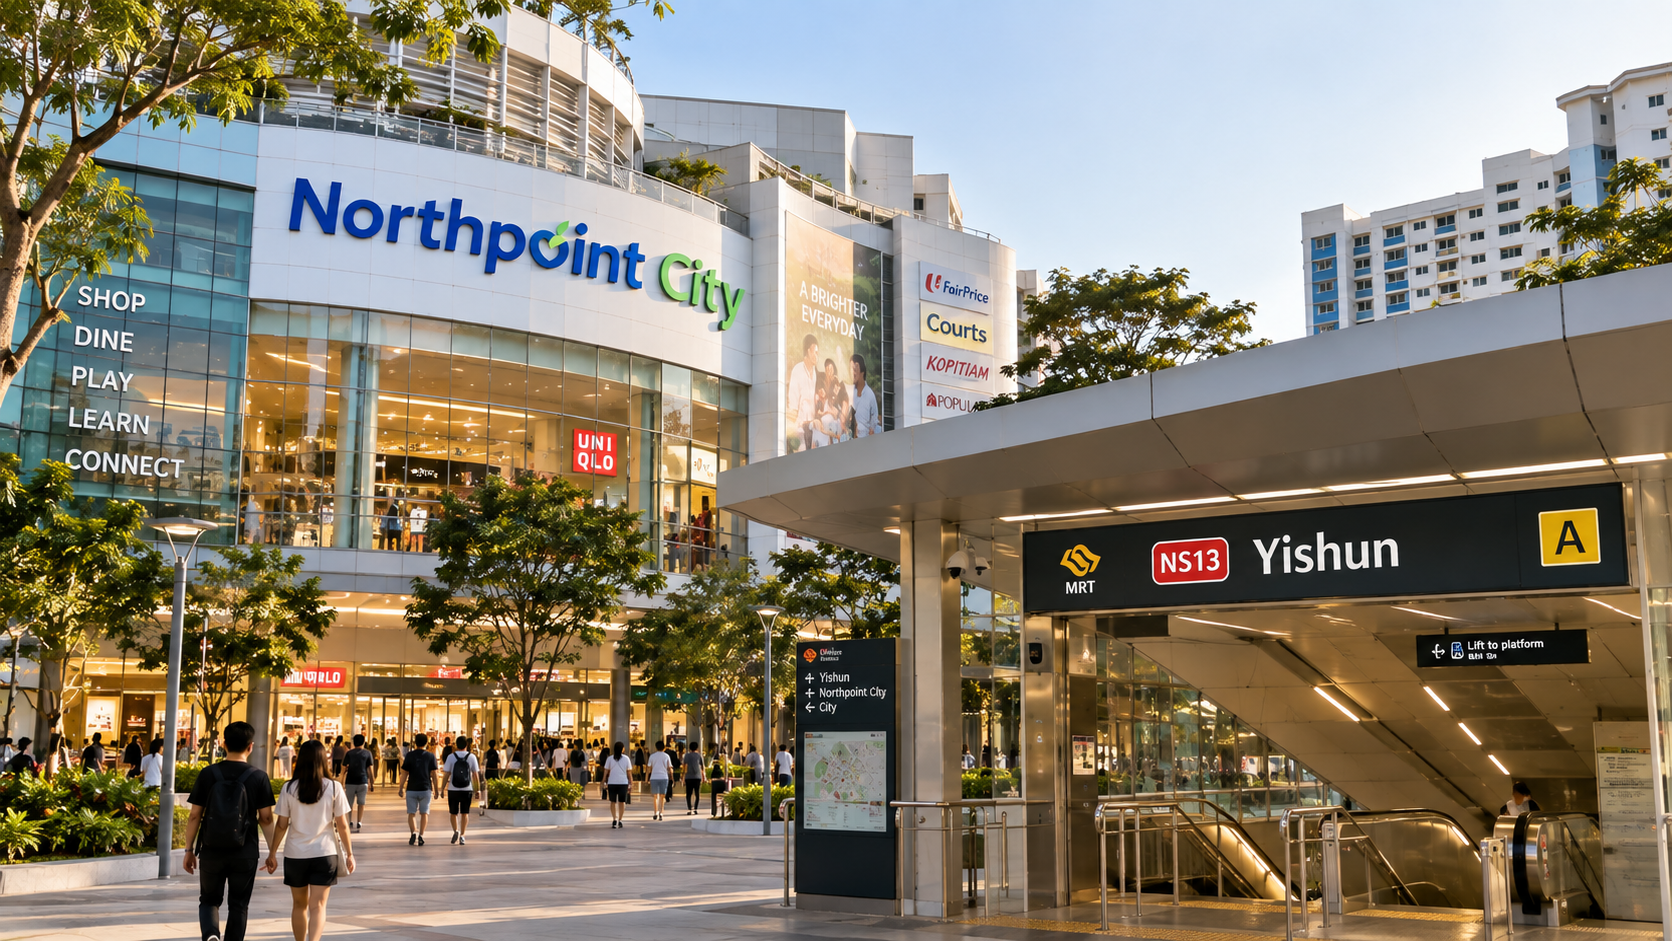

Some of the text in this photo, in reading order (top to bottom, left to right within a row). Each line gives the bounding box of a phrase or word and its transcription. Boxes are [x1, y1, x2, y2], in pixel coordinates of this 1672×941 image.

[288, 177, 746, 332] Northpoint City
[77, 285, 146, 313] SHOP
[799, 280, 869, 321] A BRIGHTER
[943, 280, 989, 304] FairPrice
[802, 303, 865, 341] EVERYDAY
[926, 312, 988, 344] Courts
[74, 325, 135, 353] DINE
[72, 365, 134, 393] PLAY
[926, 355, 990, 381] KOPITIAM
[937, 394, 974, 414] POPUL
[68, 406, 150, 436] LEARN
[578, 433, 612, 452] UNI
[65, 448, 185, 479] CONNECT
[577, 452, 614, 472] QLO
[1555, 520, 1586, 555] A
[1160, 531, 1400, 575] NS13 Yishun
[1065, 580, 1096, 595] MRT
[1467, 638, 1545, 651] Lift to platform
[819, 671, 850, 683] Yishun
[819, 686, 868, 700] Northpoint
[819, 701, 838, 715] City
